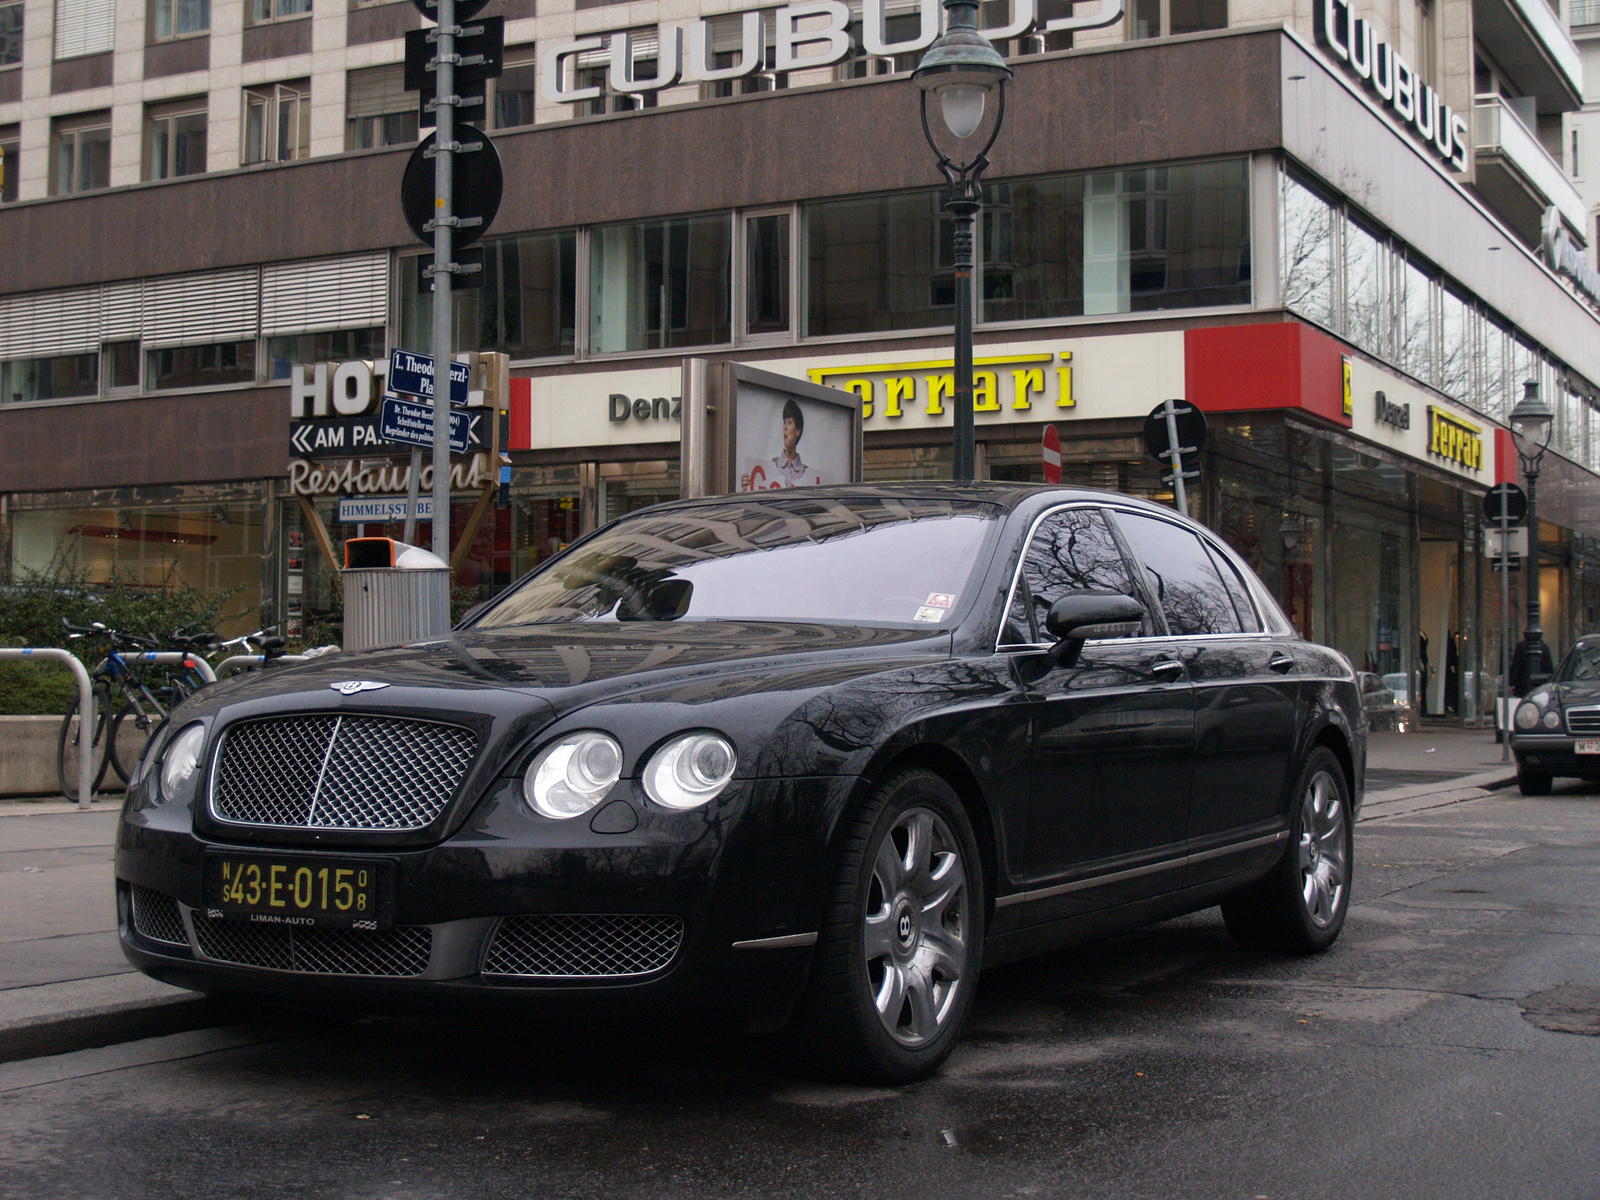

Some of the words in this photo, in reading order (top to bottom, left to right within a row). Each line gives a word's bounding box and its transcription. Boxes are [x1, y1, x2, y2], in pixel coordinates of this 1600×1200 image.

[608, 394, 681, 422] Denz
[315, 427, 344, 448] AM
[1427, 405, 1484, 471] Ferrari
[342, 502, 432, 517] HIMMELSSTBE
[250, 913, 315, 926] LIMAN-AUTO
